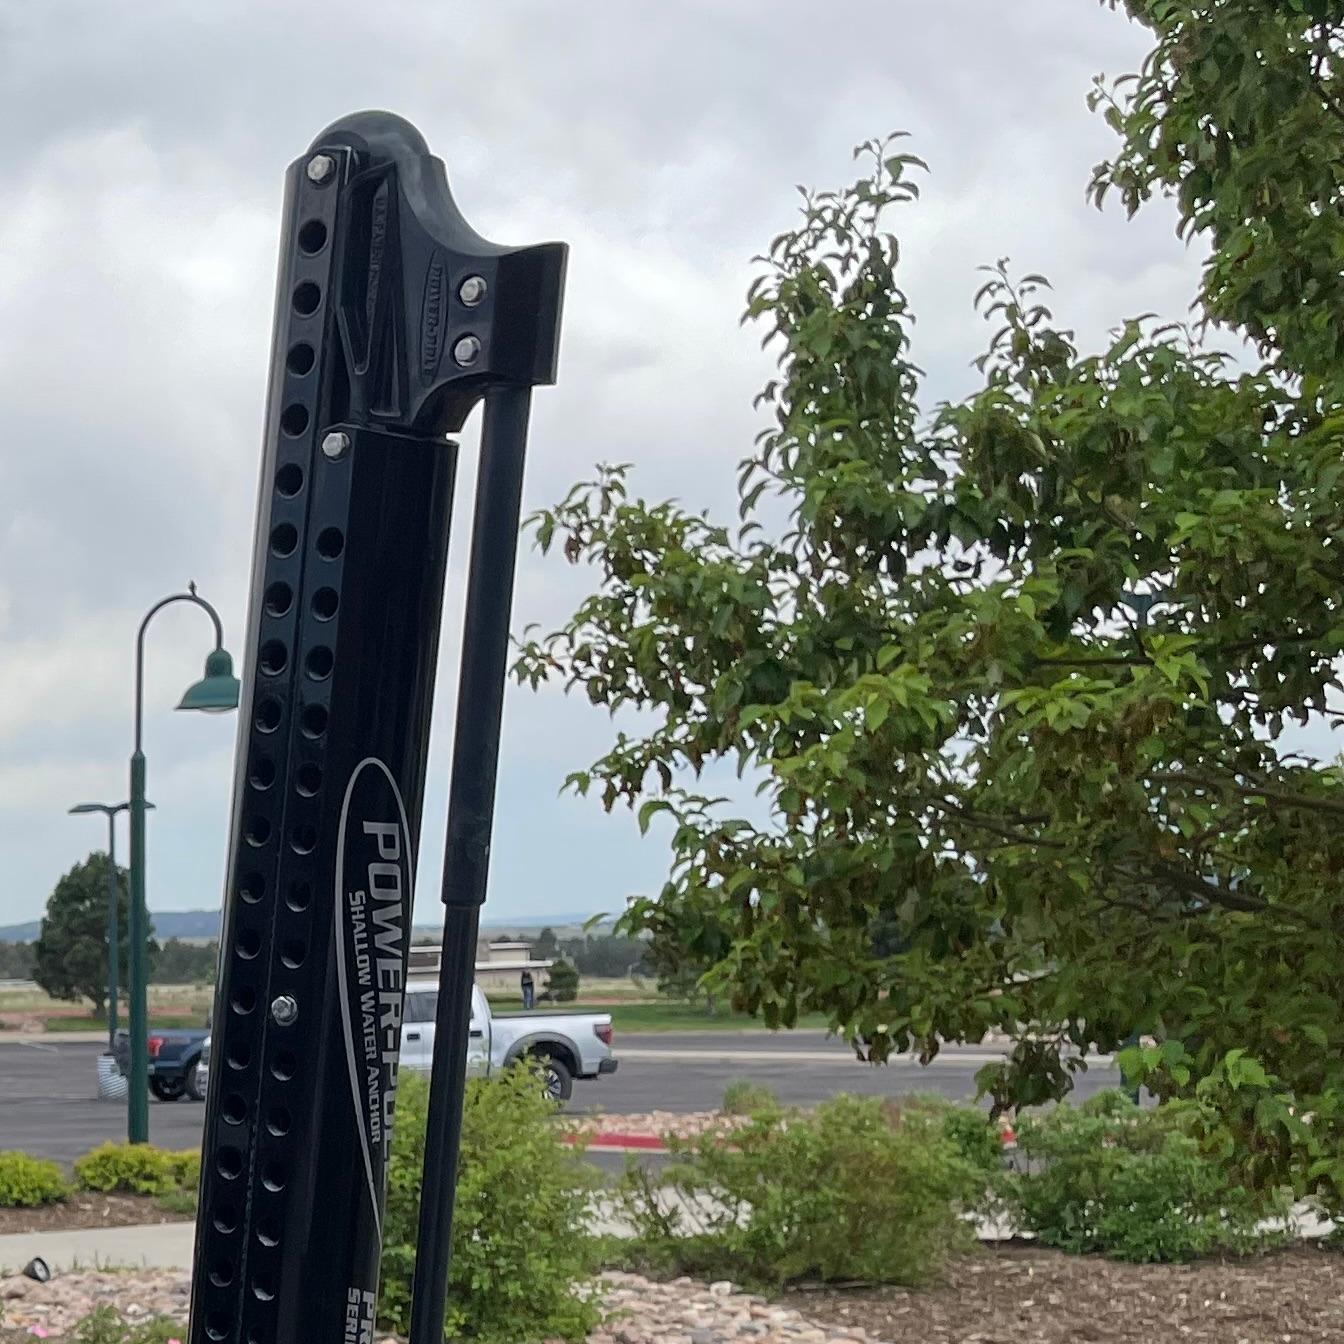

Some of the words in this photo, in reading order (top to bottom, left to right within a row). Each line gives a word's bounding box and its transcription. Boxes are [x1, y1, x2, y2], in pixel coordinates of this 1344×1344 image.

[349, 890, 371, 987] SHALLOW
[359, 991, 379, 1064] WATER
[367, 1065, 382, 1144] ANCHOR
